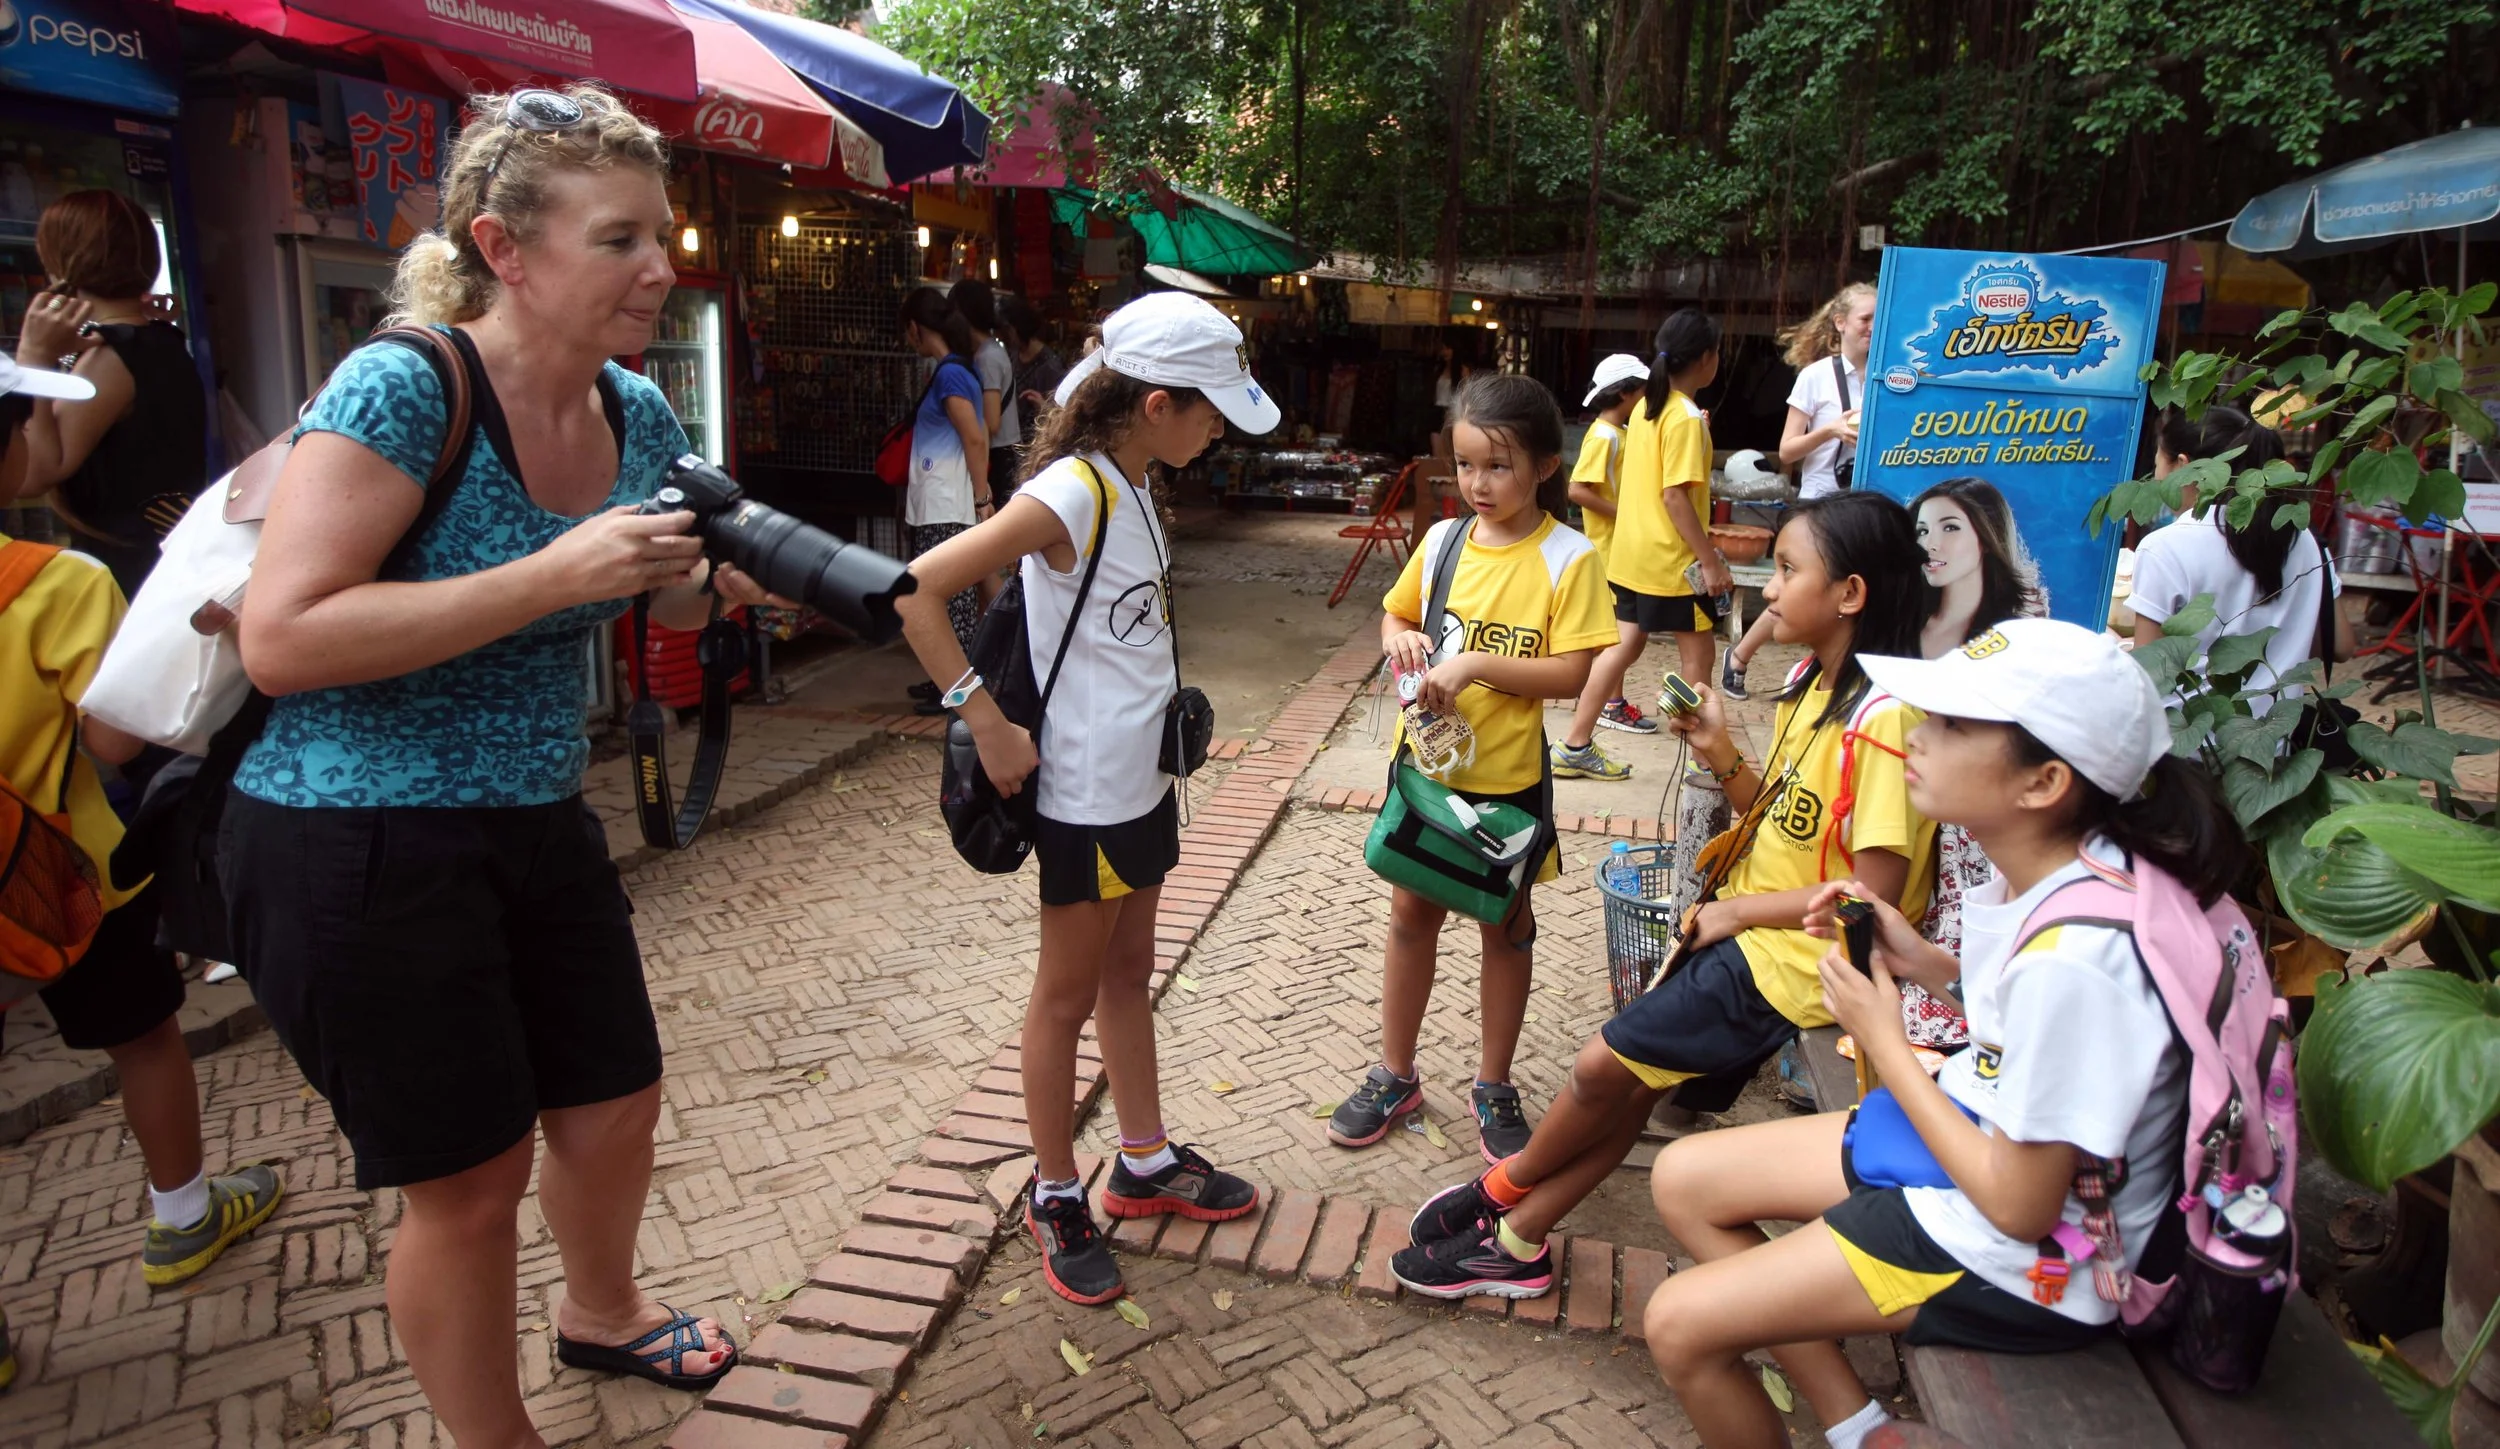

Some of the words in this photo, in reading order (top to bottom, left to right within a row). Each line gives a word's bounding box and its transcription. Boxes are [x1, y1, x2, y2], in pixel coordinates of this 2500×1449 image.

[29, 14, 144, 60] pepsi
[425, 0, 593, 54] เมองไทยประกันชีวิต
[384, 89, 416, 193] ソフト
[1978, 293, 2028, 309] Nestlé
[1988, 277, 2020, 287] ไอศกรีม
[1944, 311, 2092, 359] เอ็กซ์ตรีม
[1910, 398, 2088, 437] ยอมได้หมด
[1878, 436, 1990, 467] เพื่อรสชาติ
[641, 754, 659, 805] Nikon
